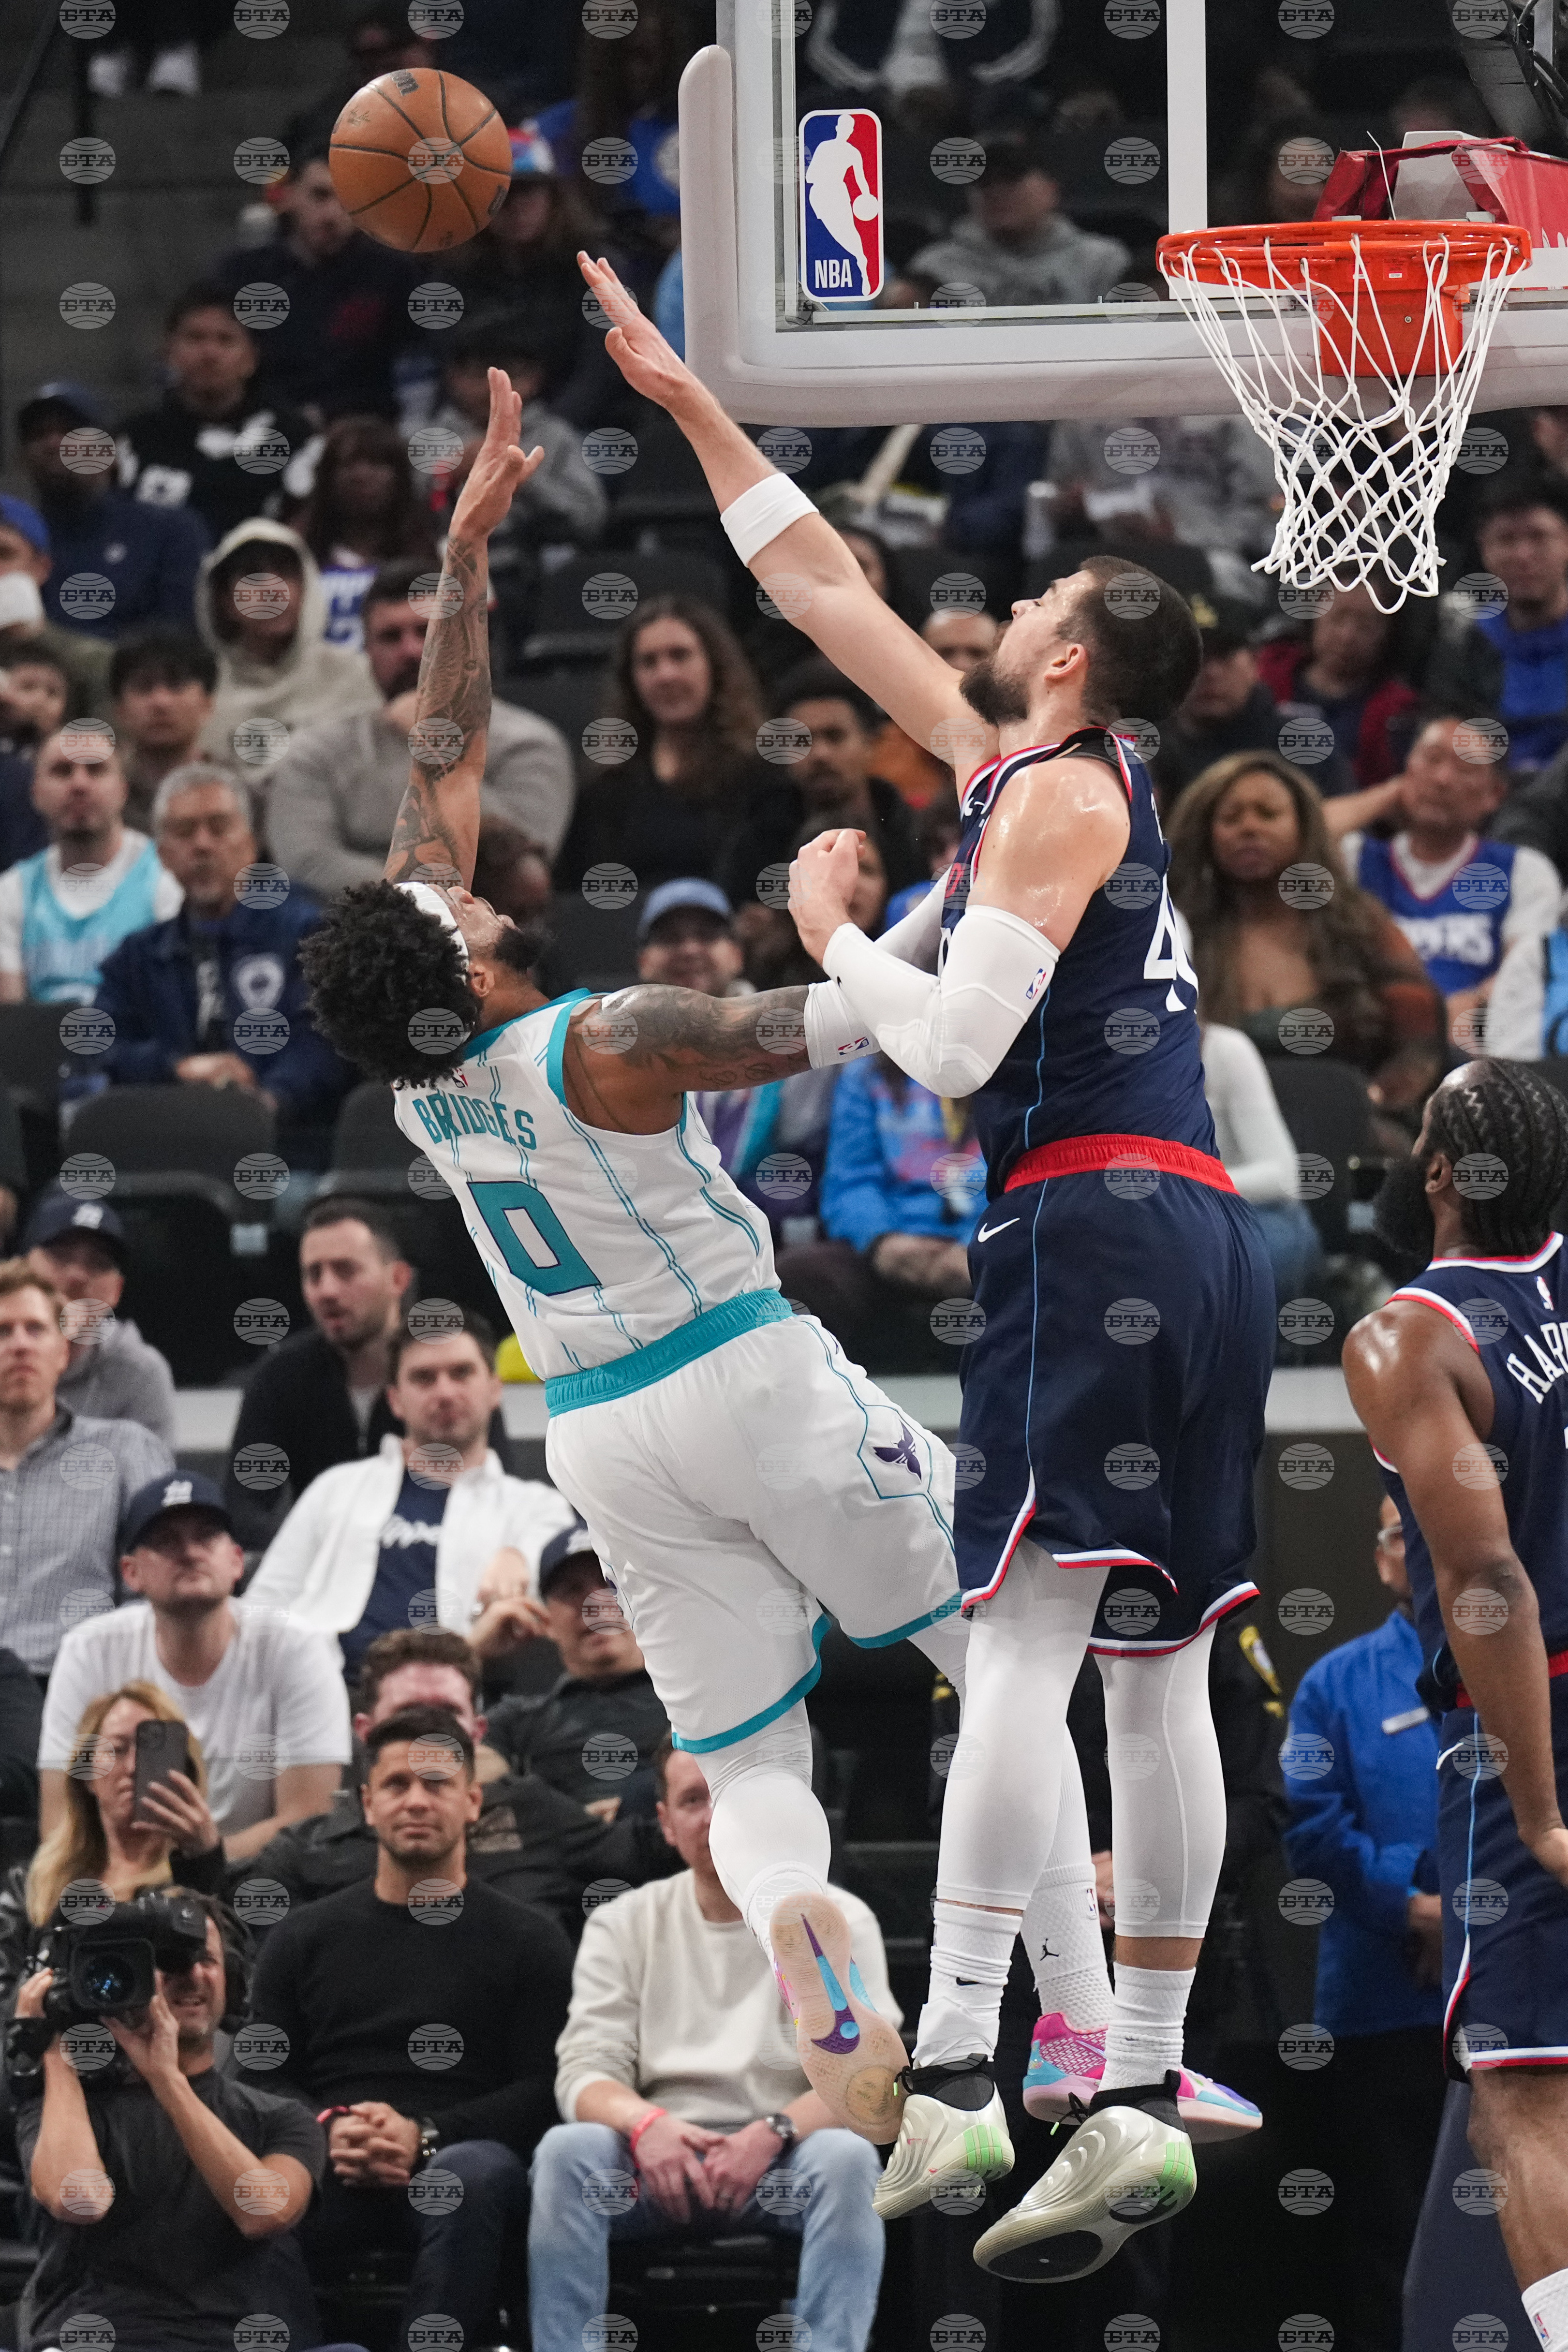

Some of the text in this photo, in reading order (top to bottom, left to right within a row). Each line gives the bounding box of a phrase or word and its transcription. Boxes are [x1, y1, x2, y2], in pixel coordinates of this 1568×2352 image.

[815, 259, 853, 288] NBA
[412, 1092, 537, 1150] BRIDGES
[467, 1181, 602, 1296] 0
